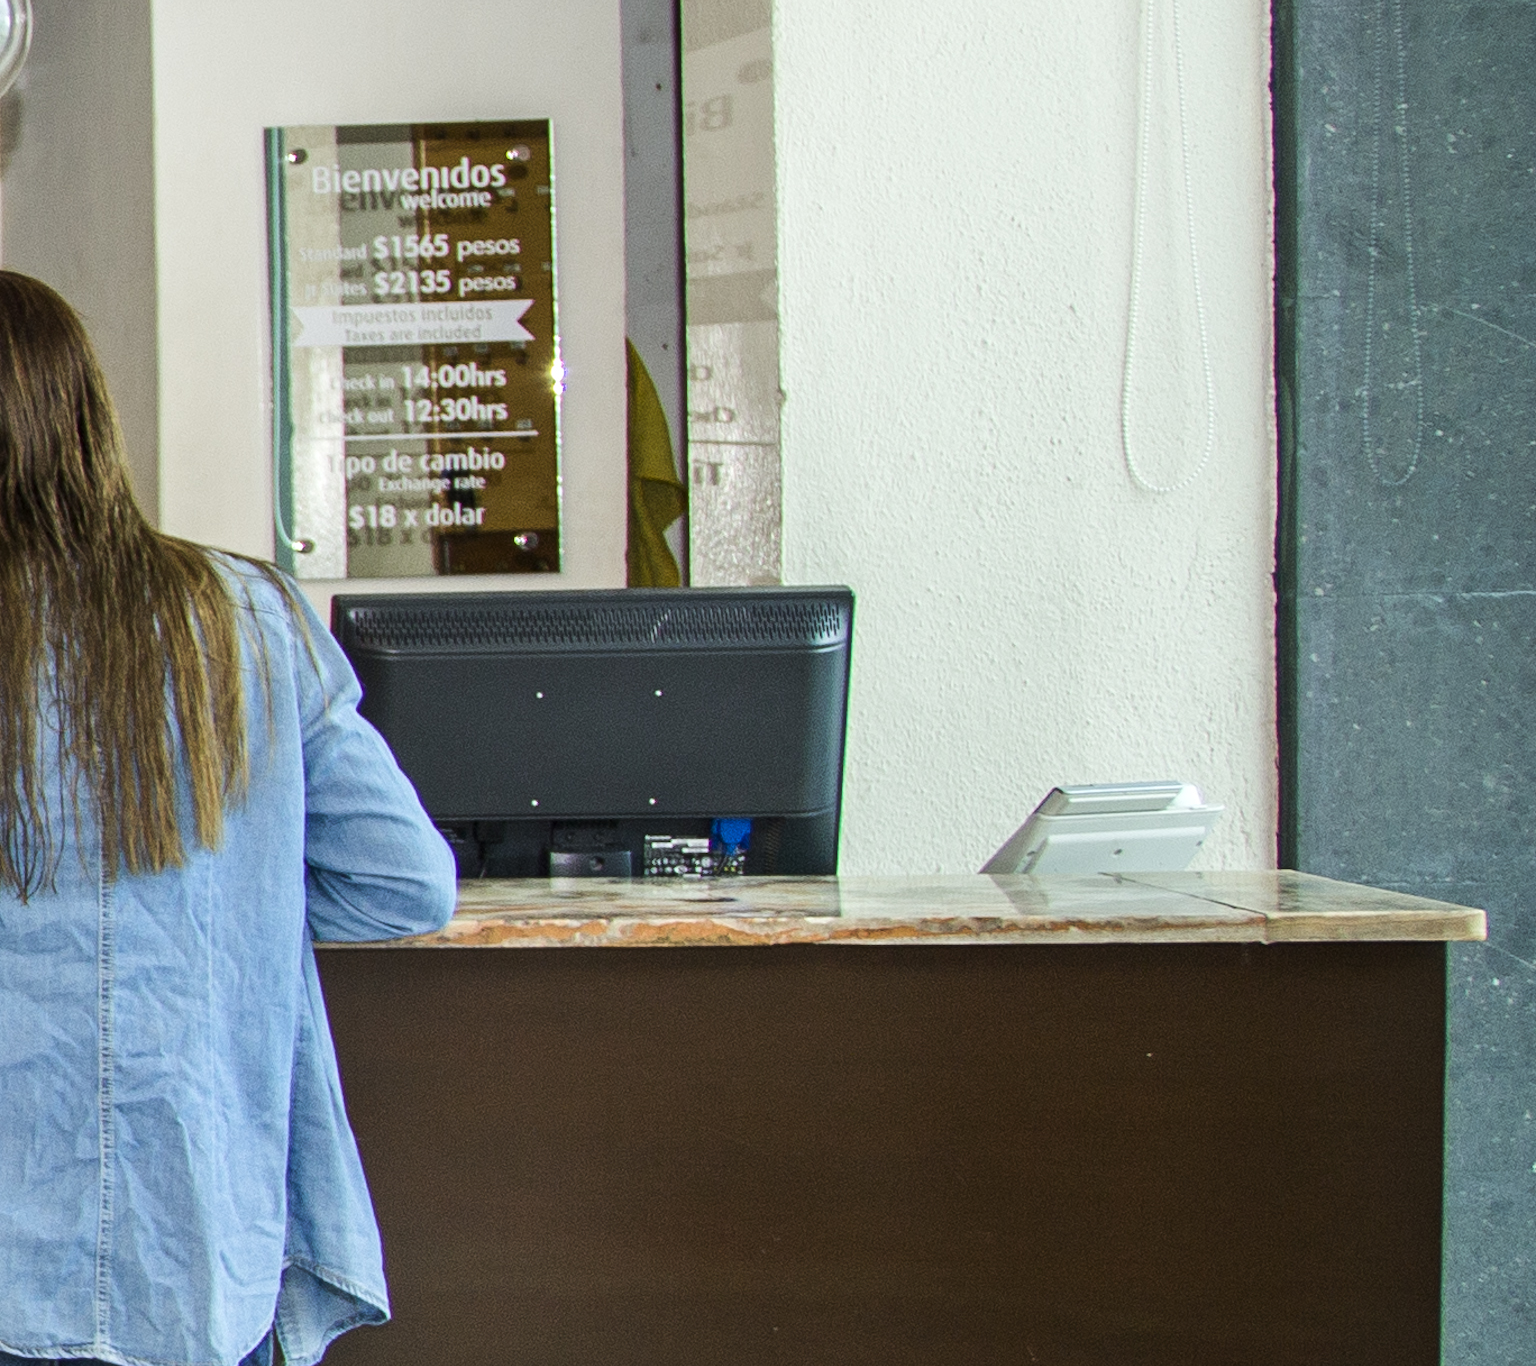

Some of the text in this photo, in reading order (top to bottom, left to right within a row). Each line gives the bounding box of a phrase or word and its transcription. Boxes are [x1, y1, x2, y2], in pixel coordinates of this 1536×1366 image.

[312, 156, 507, 194] Bienvenidos
[401, 188, 493, 209] welcome
[299, 234, 521, 262] Standard $1565 pesos
[374, 270, 452, 295] $2135
[458, 275, 517, 298] pesos
[332, 304, 493, 327] Impuestos incluidos
[345, 324, 483, 342] Taxes are included
[379, 373, 395, 389] in
[402, 362, 507, 389] 14:00hrs
[367, 408, 394, 423] out
[403, 395, 509, 423] 12:30hrs
[382, 448, 414, 473] de
[420, 446, 506, 471] cambio
[378, 474, 486, 494] Exchange rate
[348, 501, 488, 530] $18 x dolar
